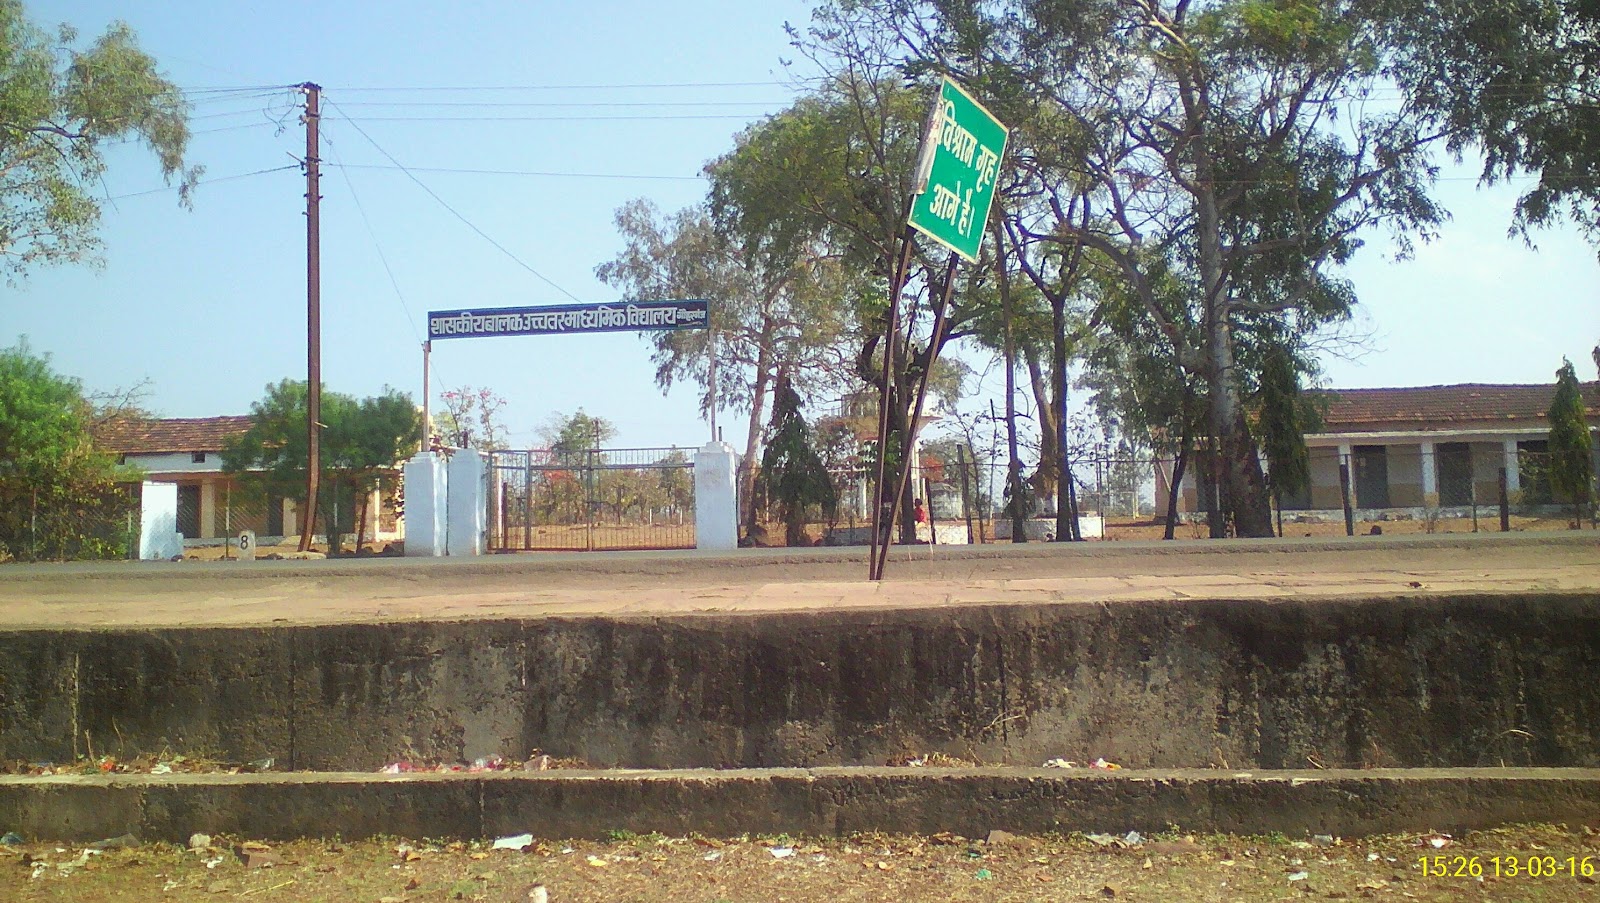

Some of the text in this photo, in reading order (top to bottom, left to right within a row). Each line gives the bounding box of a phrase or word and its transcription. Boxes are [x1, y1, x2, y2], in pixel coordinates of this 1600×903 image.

[975, 143, 999, 193] गृह
[929, 181, 961, 226] आगे
[626, 304, 678, 327] विद्यालय
[240, 535, 249, 550] 8
